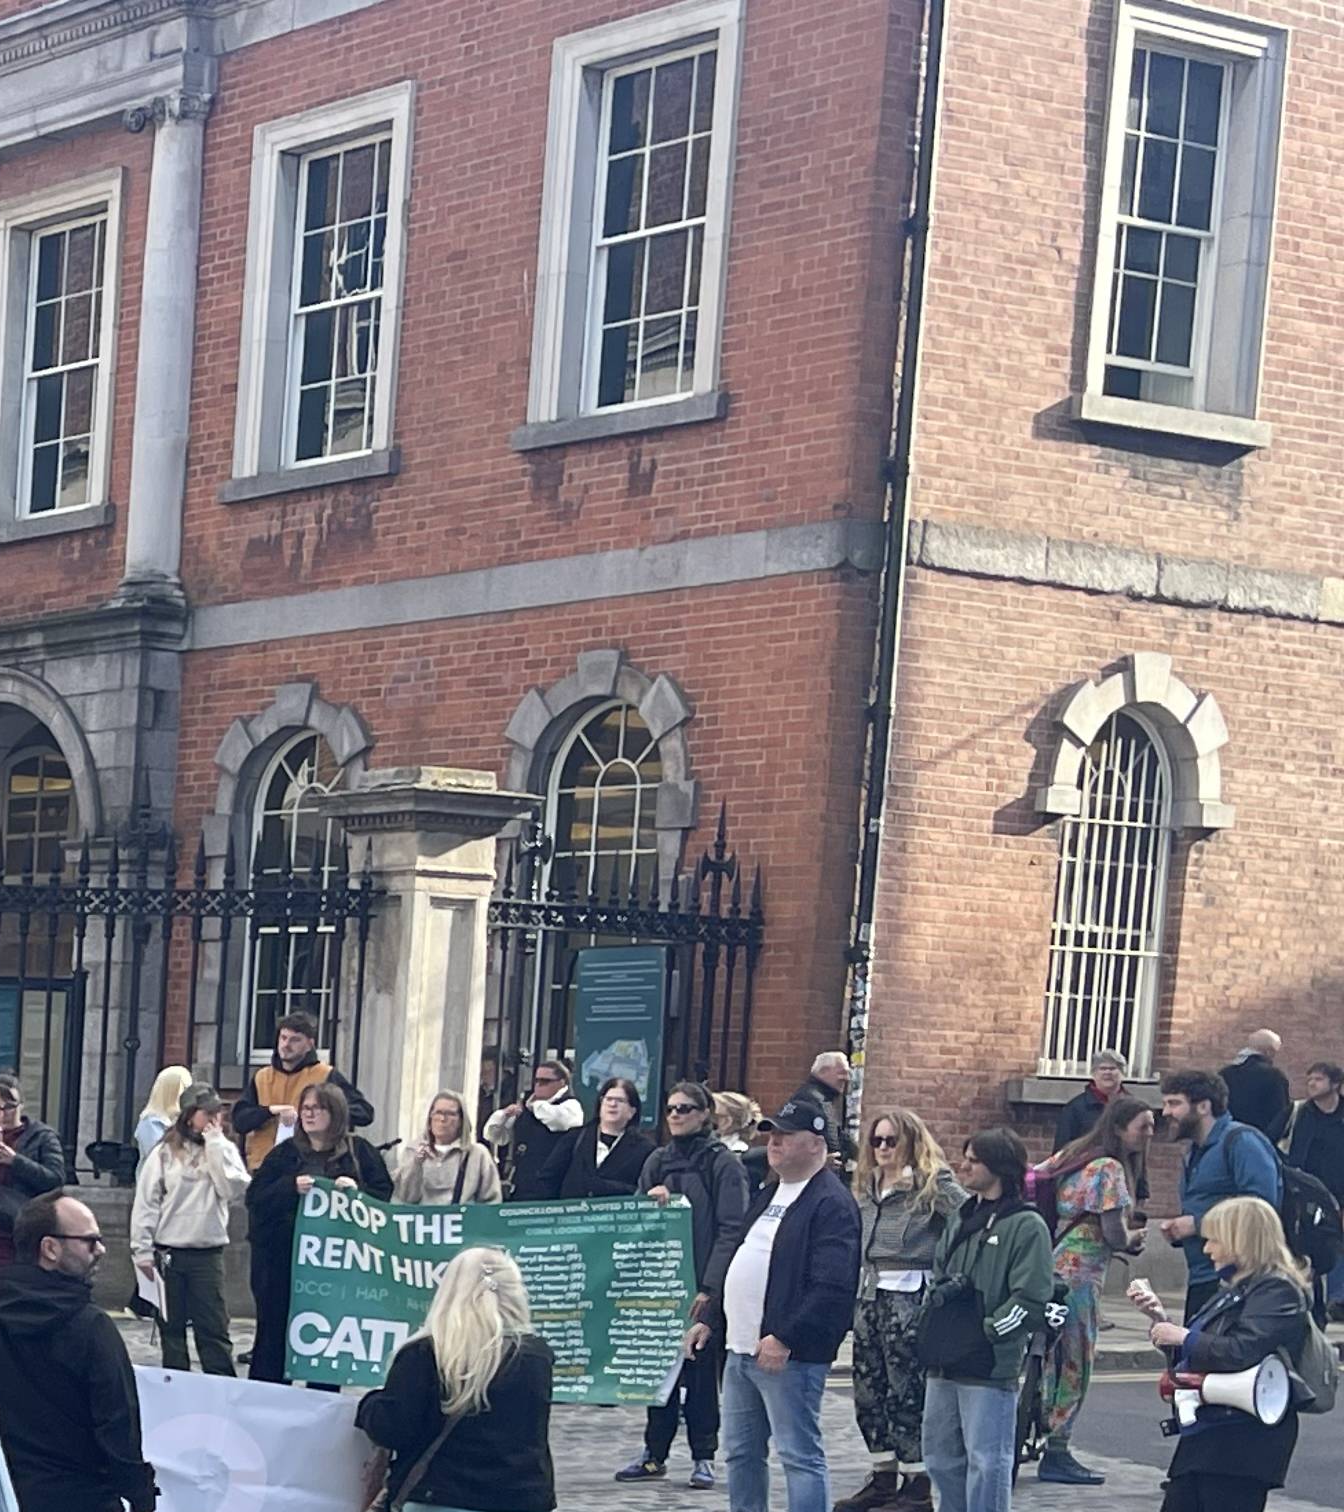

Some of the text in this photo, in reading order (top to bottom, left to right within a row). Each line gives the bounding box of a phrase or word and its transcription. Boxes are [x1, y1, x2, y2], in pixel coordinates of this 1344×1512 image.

[303, 1187, 463, 1245] DROP THE
[297, 1234, 449, 1289] RENT HIK
[292, 1358, 380, 1373] IRELA
